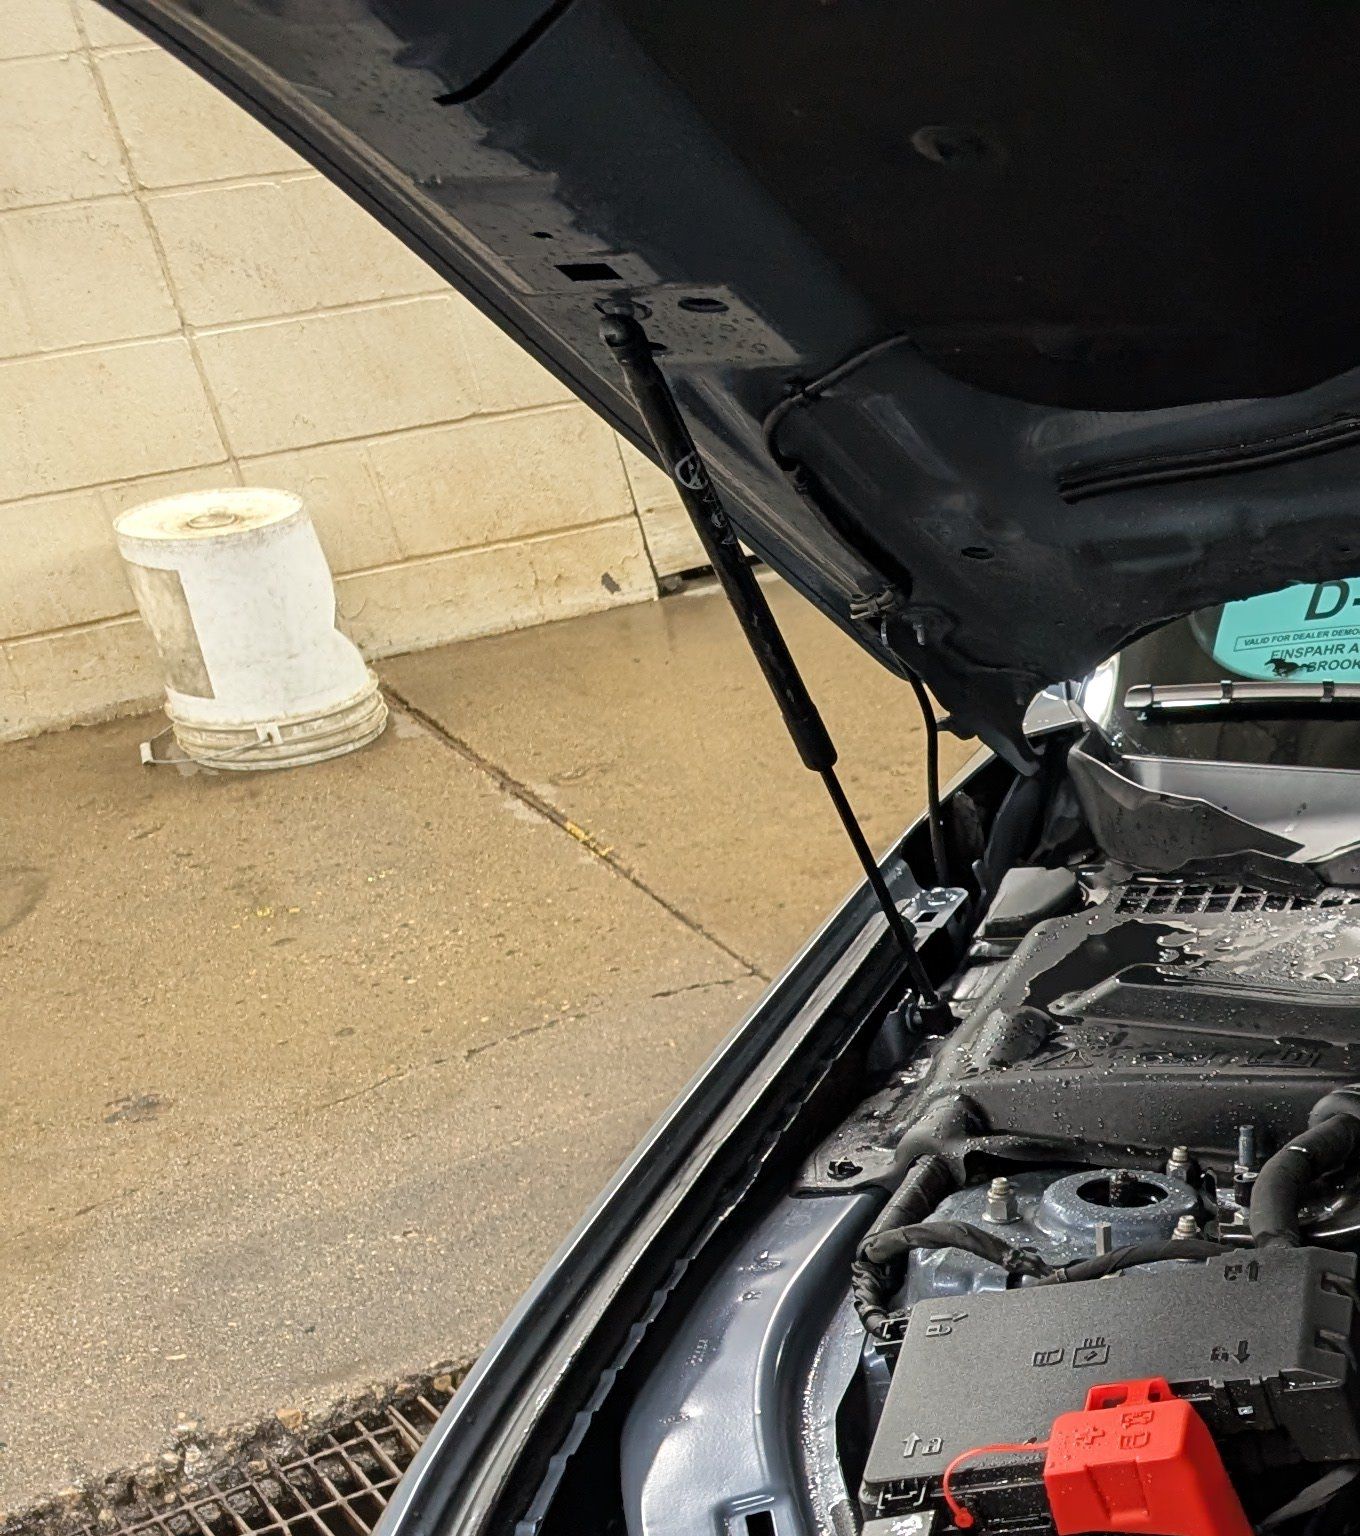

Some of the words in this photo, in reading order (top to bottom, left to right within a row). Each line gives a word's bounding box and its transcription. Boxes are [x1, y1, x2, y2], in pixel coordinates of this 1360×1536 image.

[1244, 637, 1270, 646] VALID
[1271, 634, 1290, 643] FOR
[1292, 630, 1330, 641] DEALER
